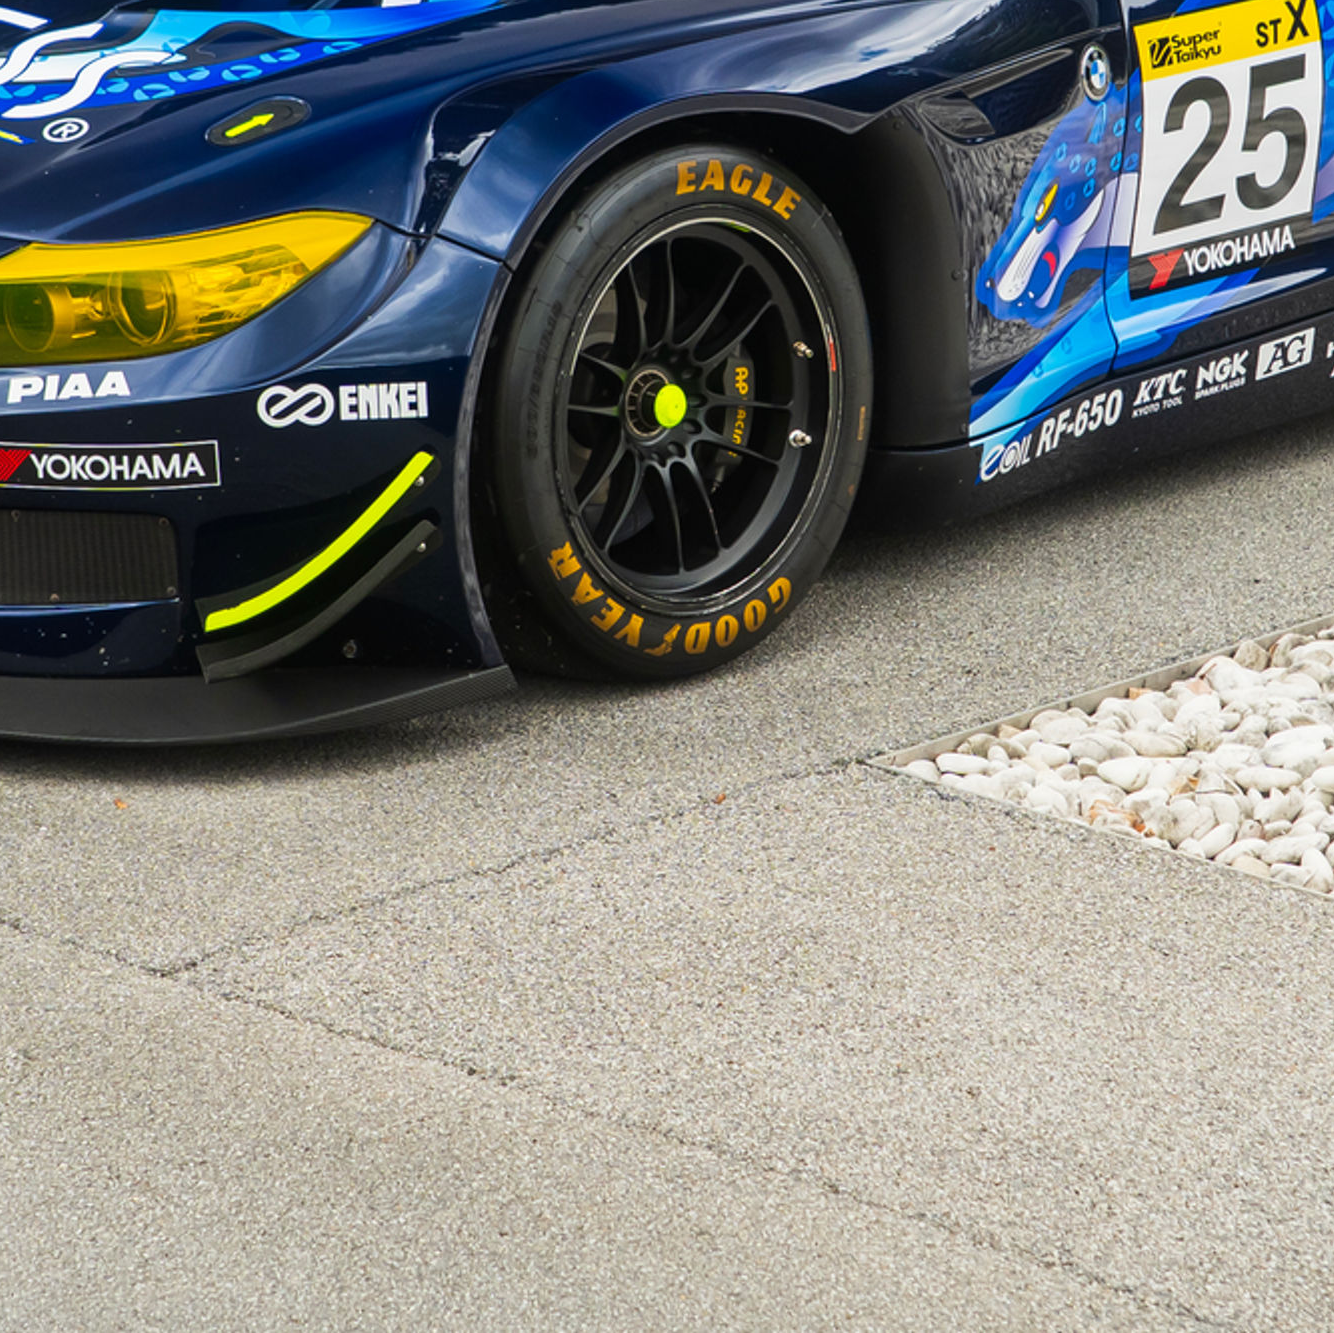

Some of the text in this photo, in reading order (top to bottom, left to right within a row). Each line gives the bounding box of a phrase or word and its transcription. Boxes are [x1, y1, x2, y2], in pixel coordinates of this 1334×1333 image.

[1170, 28, 1221, 50] Super
[1173, 43, 1222, 66] Taikyu
[1152, 53, 1309, 237] 25
[675, 157, 803, 221] EAGLE
[1182, 223, 1296, 279] YOKOHAMA
[6, 370, 131, 404] PIAA
[1132, 369, 1188, 408] KTC
[1195, 349, 1250, 390] NGK
[339, 381, 428, 422] ENKEI
[1034, 388, 1124, 459] RF-650
[29, 451, 206, 481] YOKOHAMA
